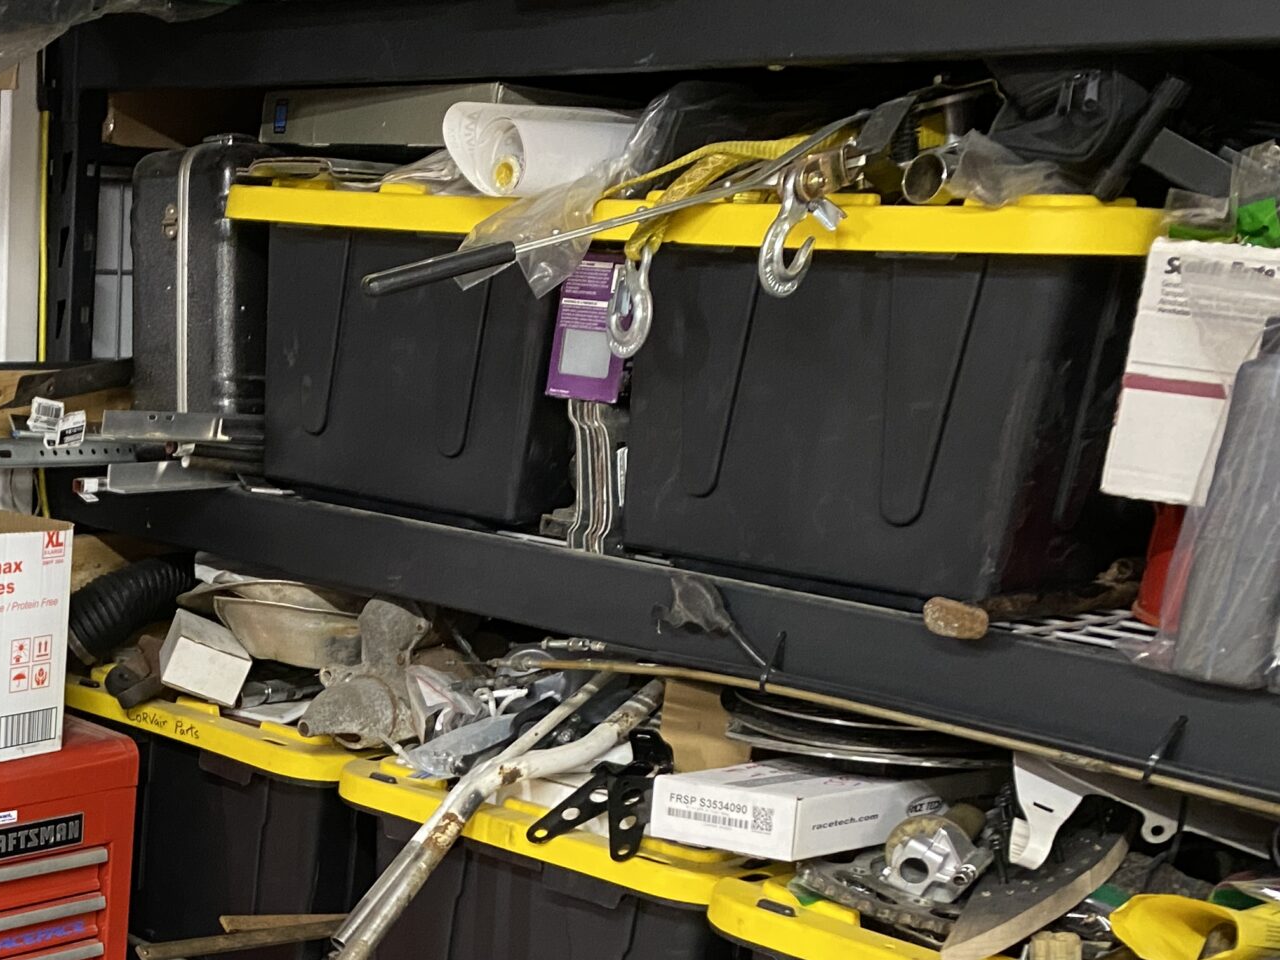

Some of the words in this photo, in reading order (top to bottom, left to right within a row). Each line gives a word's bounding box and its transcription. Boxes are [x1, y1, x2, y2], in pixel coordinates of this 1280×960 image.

[45, 531, 64, 549] XL
[11, 599, 39, 611] Protein
[41, 597, 59, 607] Free
[174, 720, 200, 739] Parts
[669, 793, 697, 805] FRSP
[699, 797, 748, 815] S3534090
[811, 813, 879, 831] racetech.com
